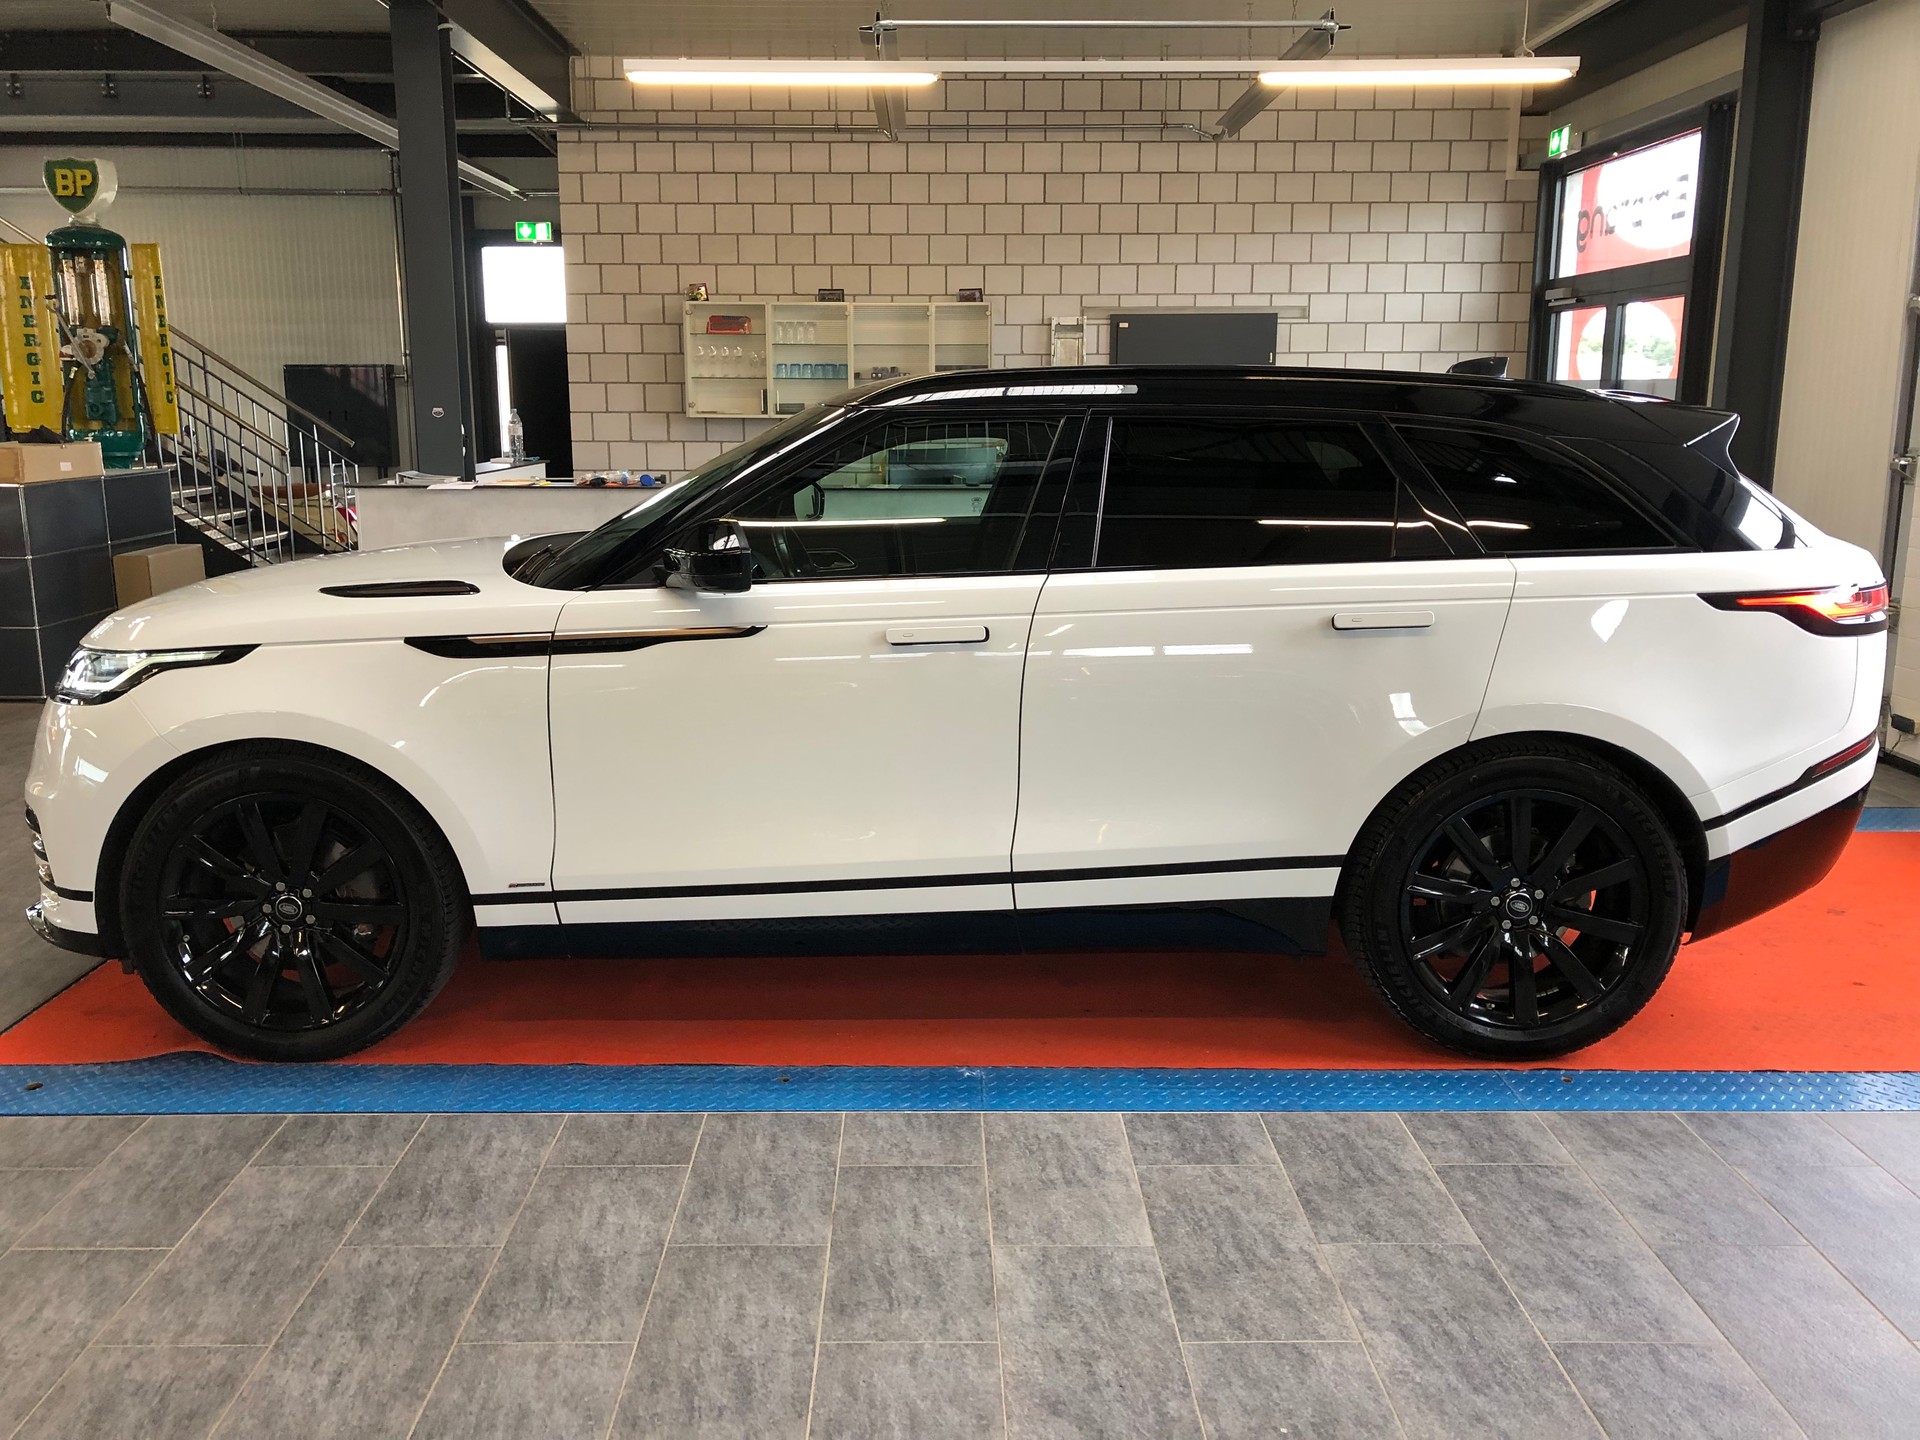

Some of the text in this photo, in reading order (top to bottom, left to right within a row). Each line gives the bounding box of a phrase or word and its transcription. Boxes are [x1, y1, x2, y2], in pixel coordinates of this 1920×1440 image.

[54, 167, 94, 197] BP
[19, 275, 45, 404] ENERGIC
[154, 275, 174, 404] ENERGIC
